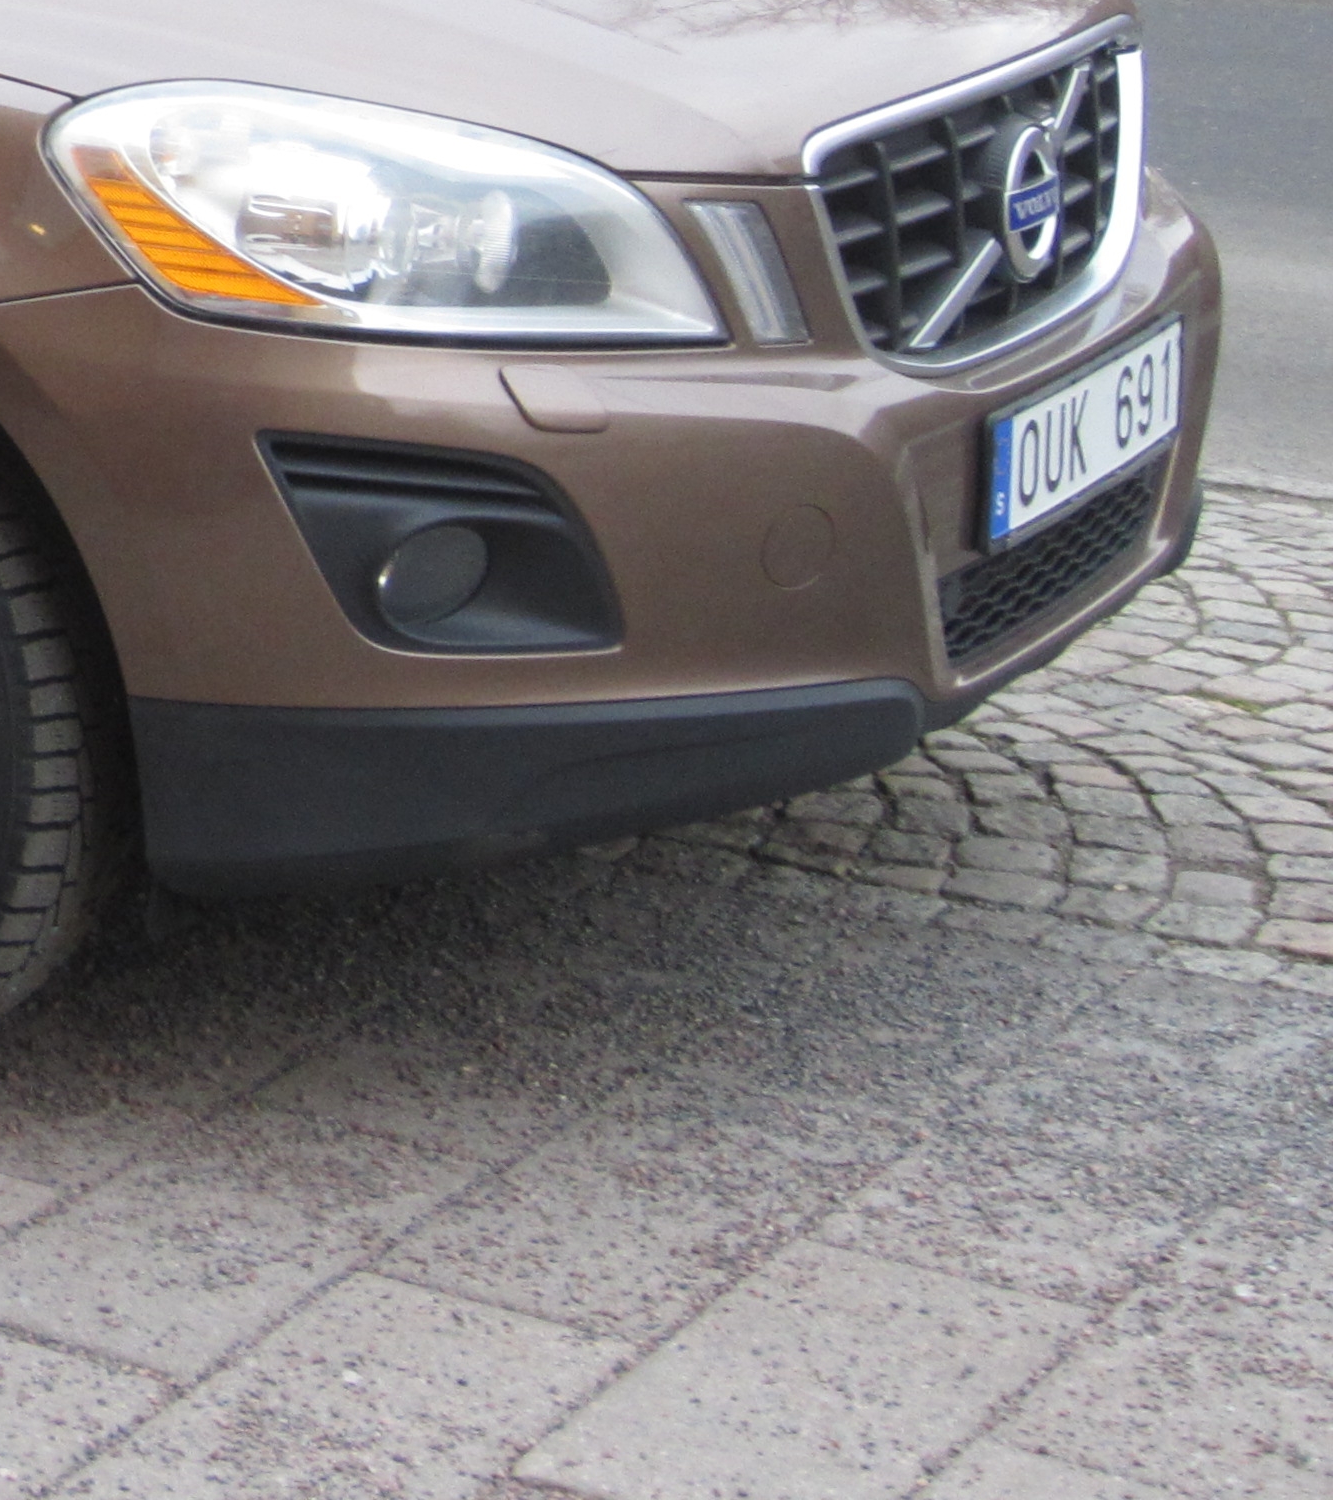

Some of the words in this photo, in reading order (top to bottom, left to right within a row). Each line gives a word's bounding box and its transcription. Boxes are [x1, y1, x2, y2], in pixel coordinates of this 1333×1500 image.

[1018, 389, 1089, 507] OUK
[1115, 339, 1172, 450] 691
[994, 490, 1006, 516] S
